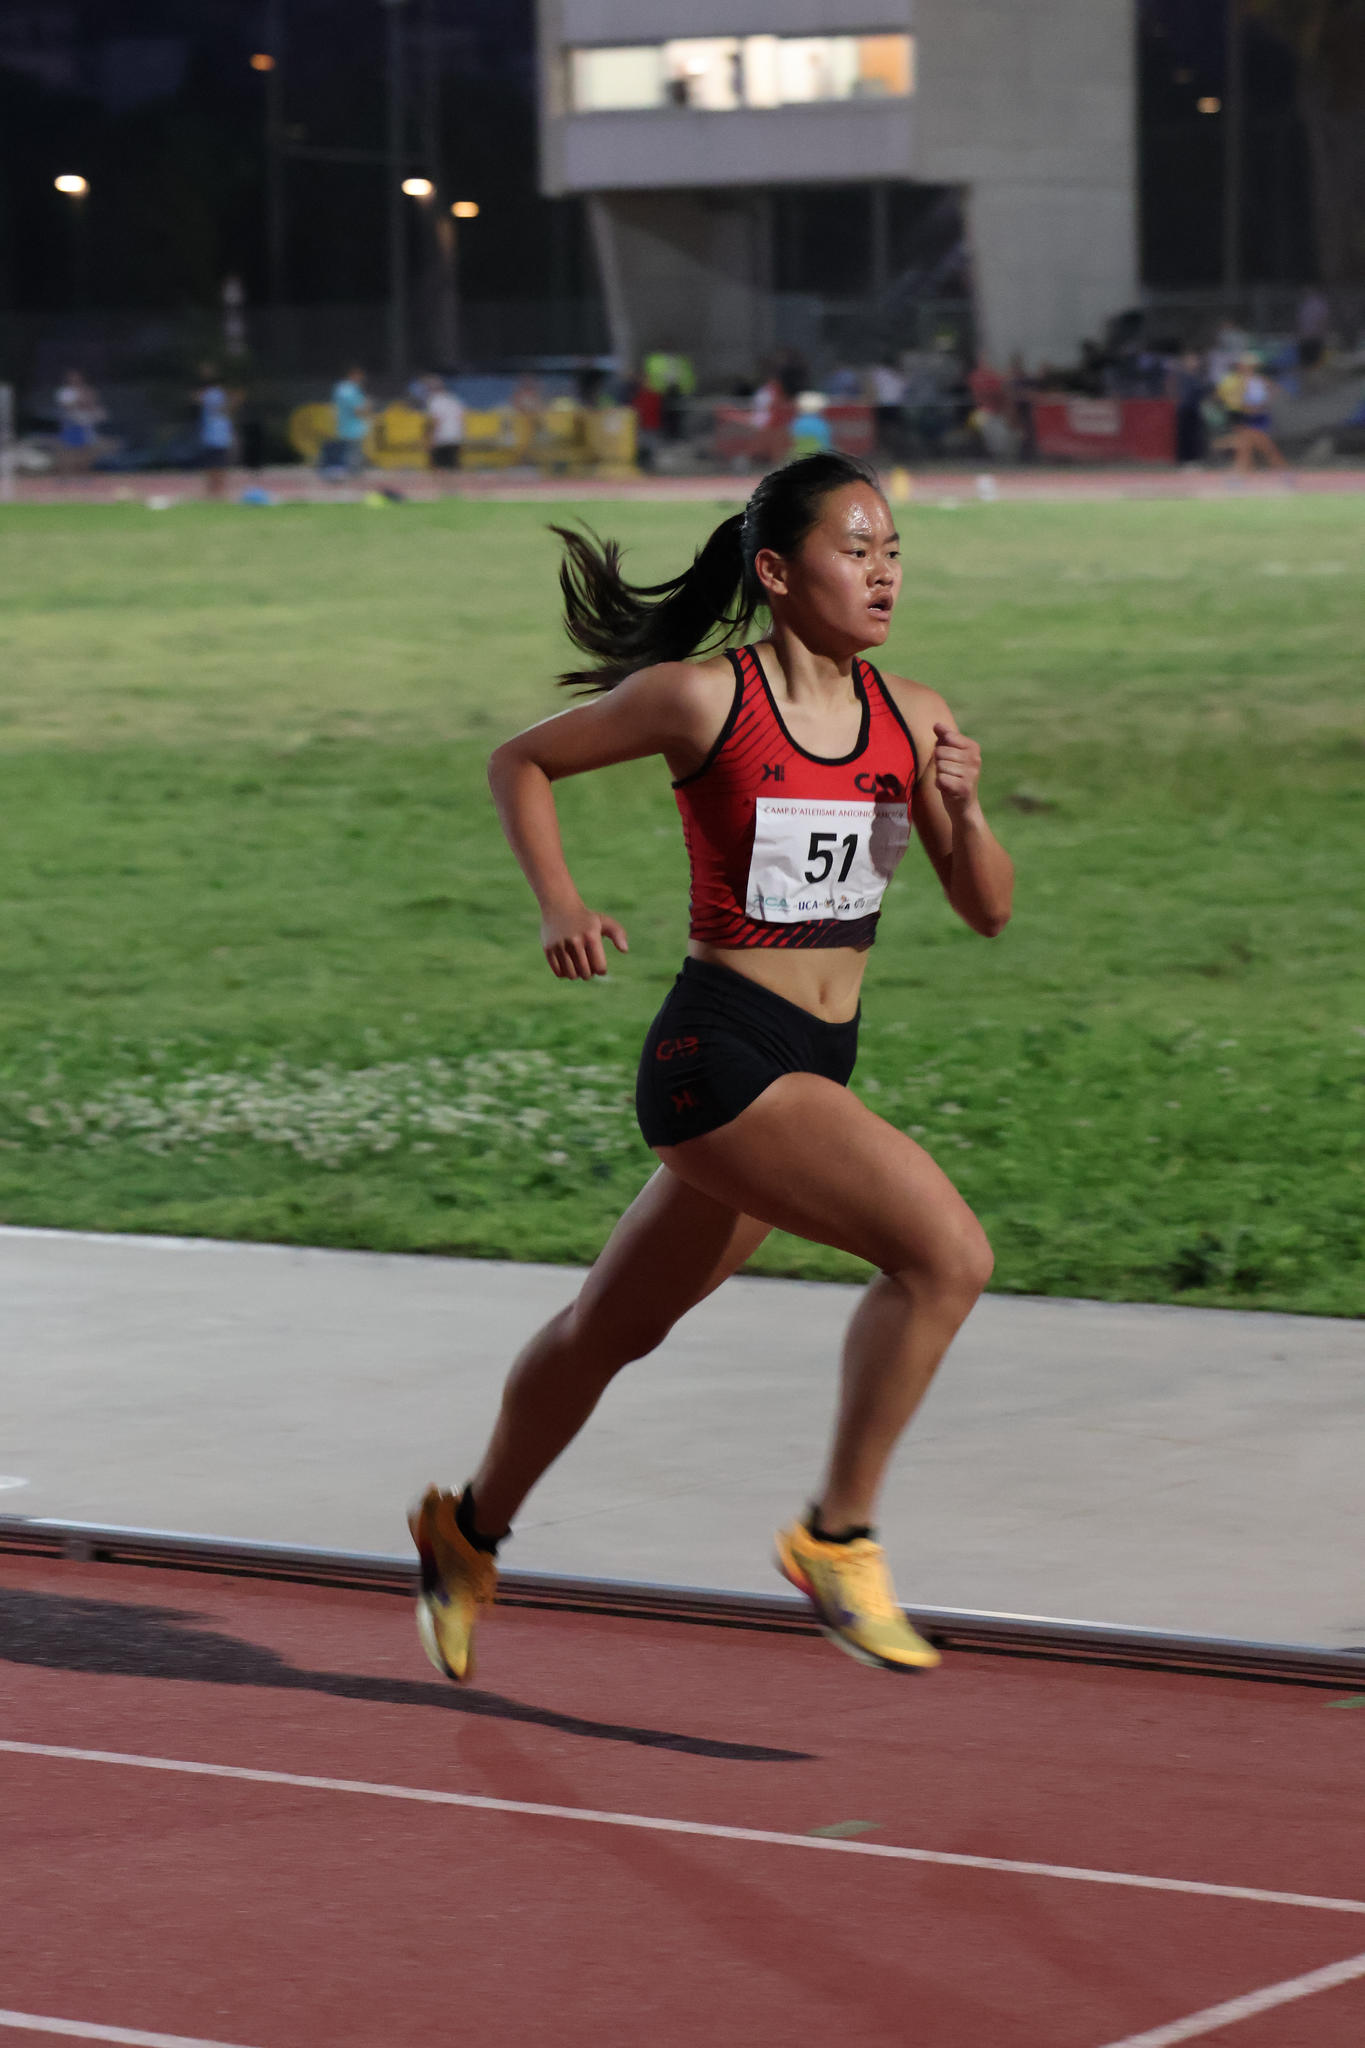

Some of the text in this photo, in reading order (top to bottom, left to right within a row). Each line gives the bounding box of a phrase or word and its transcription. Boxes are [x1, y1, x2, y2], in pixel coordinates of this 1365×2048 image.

[764, 806, 789, 815] CAMP
[791, 807, 836, 817] D'ATLETISME
[838, 809, 874, 818] ANTONIO
[804, 832, 859, 884] 51
